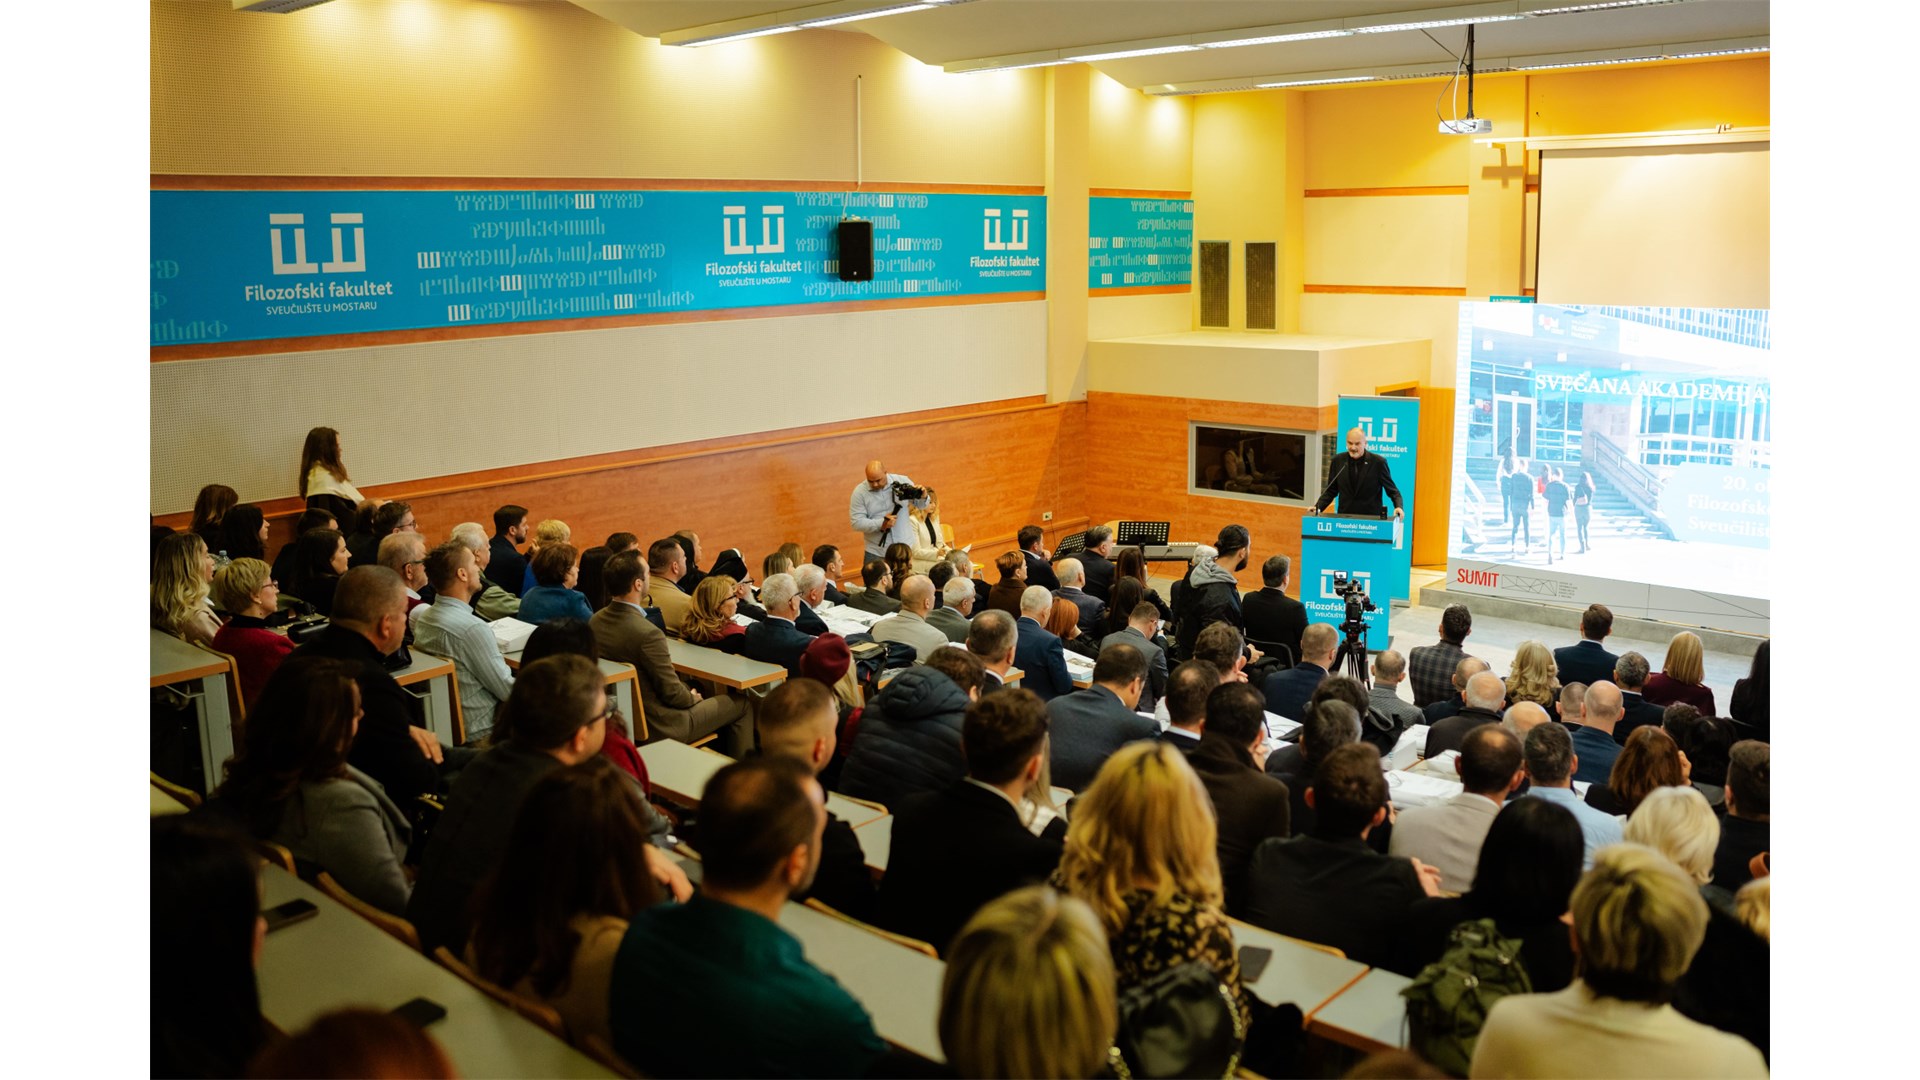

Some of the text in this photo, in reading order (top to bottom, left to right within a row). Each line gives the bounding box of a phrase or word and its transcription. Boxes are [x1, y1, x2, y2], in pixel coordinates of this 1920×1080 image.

[705, 260, 757, 276] Filozofski
[759, 259, 802, 273] fakultet
[970, 255, 1040, 267] Filozofski fakultet
[718, 277, 755, 287] SVEUČILIŠTE
[761, 276, 792, 284] MOSTARU
[245, 280, 394, 301] Filozofski fakultet
[266, 301, 378, 316] SVEUČILIŠTE U MOSTARU
[1535, 373, 1769, 406] SVEČANA AKADEMIJA
[1379, 444, 1408, 453] fakultet
[1722, 475, 1750, 492] 20.
[1687, 494, 1771, 515] Filozofsk
[1457, 568, 1499, 588] SUMIT
[1305, 601, 1346, 611] Filozofski
